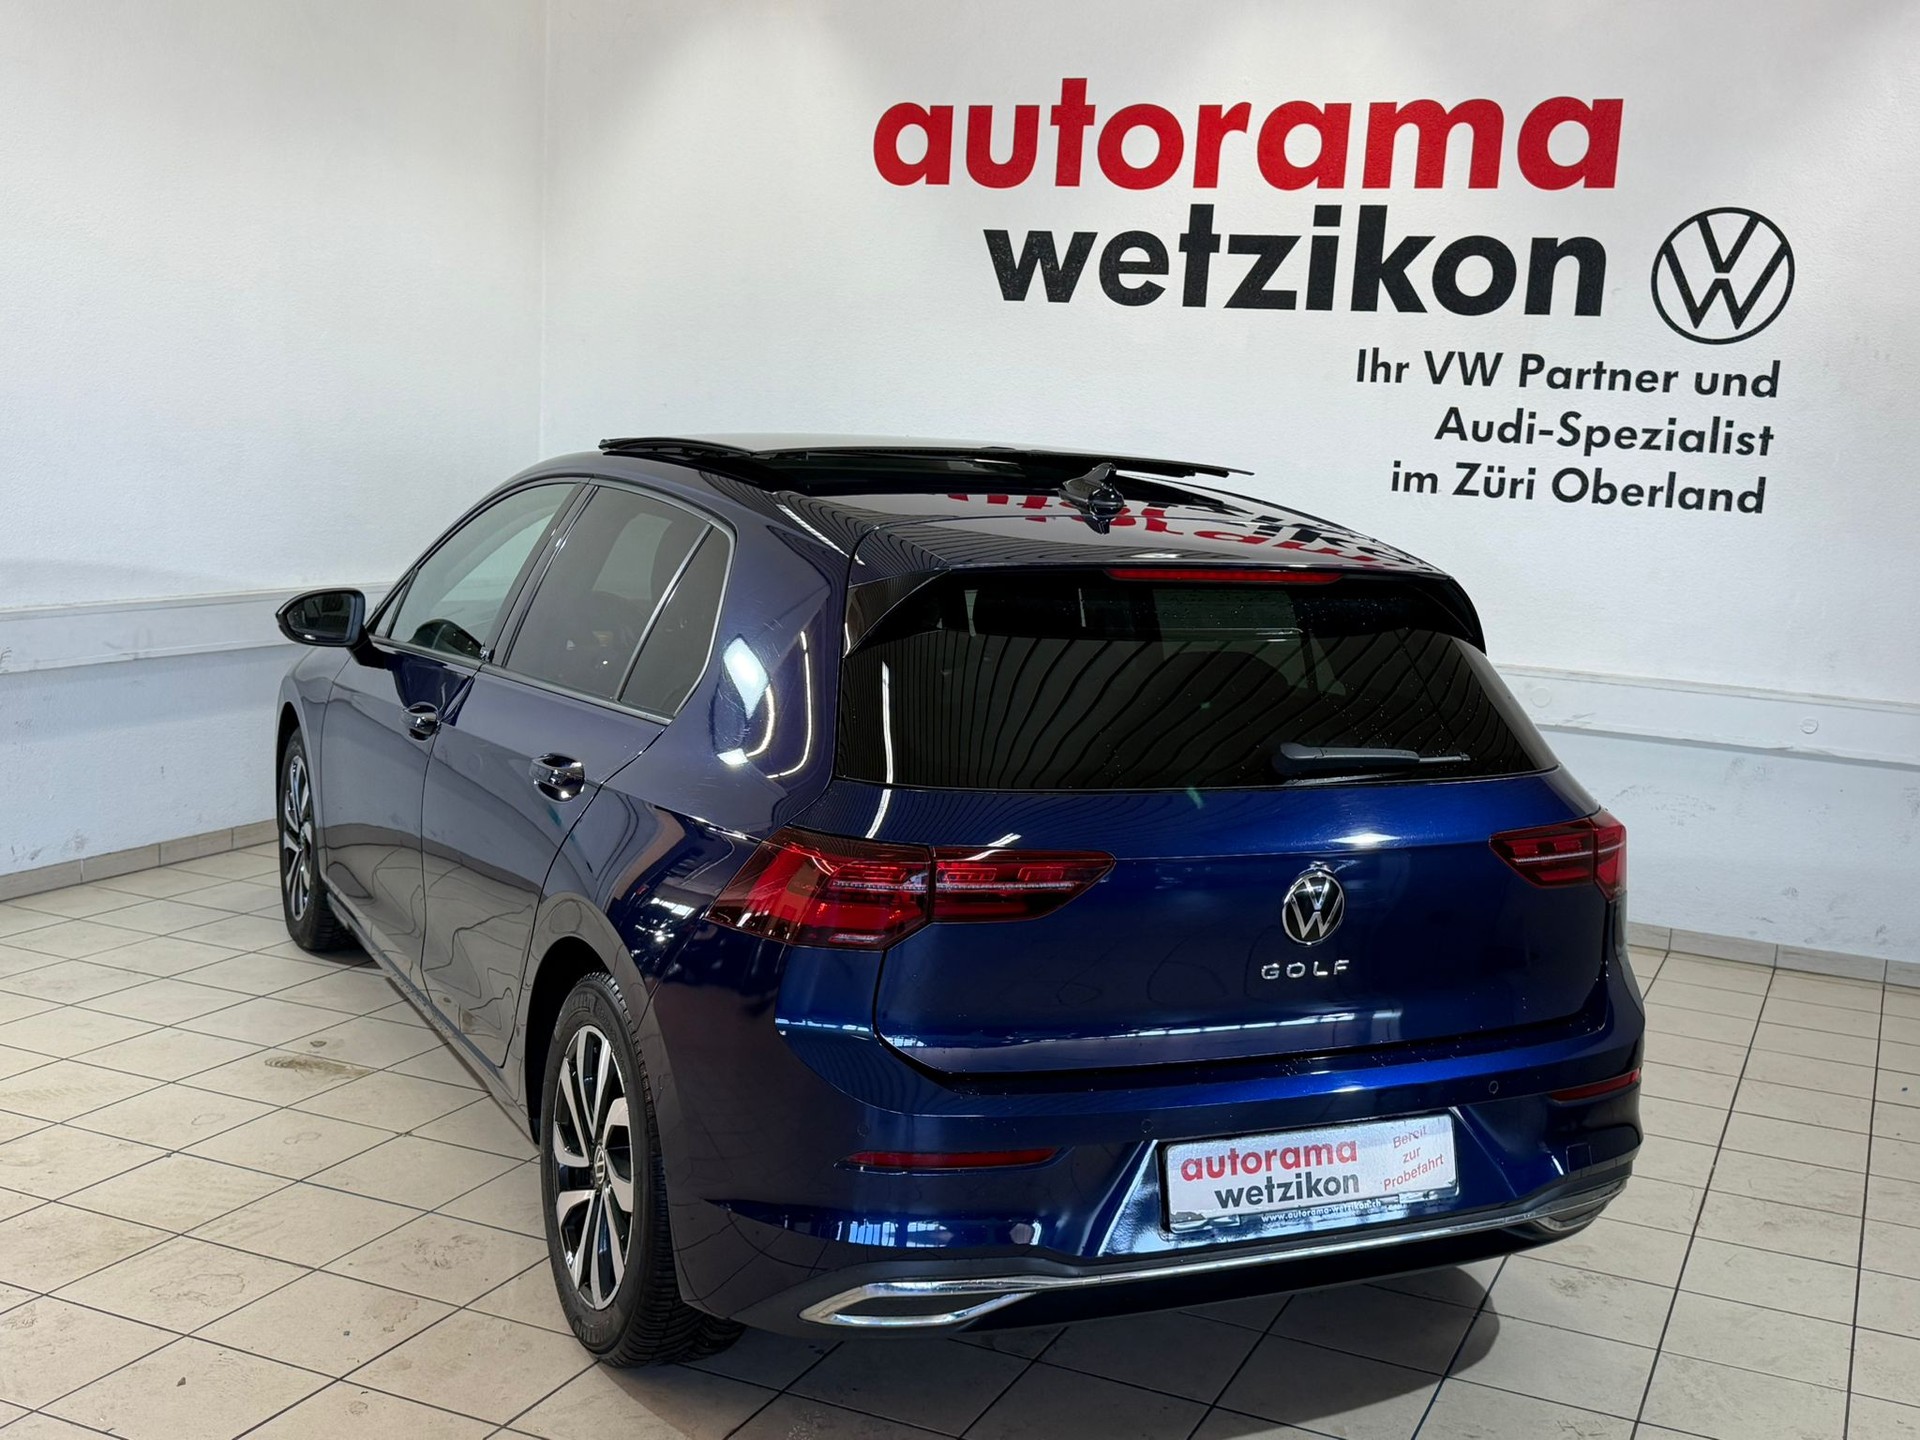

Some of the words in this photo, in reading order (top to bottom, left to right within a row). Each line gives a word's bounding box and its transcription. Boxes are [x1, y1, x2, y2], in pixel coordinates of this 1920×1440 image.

[874, 78, 1623, 190] autorama
[984, 204, 1606, 316] wetzikon
[1357, 348, 1410, 384] Ihr
[1424, 351, 1503, 386] VW
[1519, 353, 1679, 393] Partner
[1694, 360, 1780, 398] und
[1435, 406, 1775, 457] Audi-Spezialist
[1392, 460, 1438, 494] im
[1453, 462, 1535, 500] Züri
[1552, 467, 1766, 514] Oberland
[1261, 960, 1350, 980] GOLF
[1392, 1125, 1428, 1149] Bereit
[1402, 1145, 1422, 1165] zur
[1180, 1140, 1358, 1182] autorama
[1383, 1153, 1445, 1191] Probefahrt
[1214, 1172, 1360, 1210] wetzikon
[1261, 1198, 1382, 1223] www.autorama-wetzikon.ch
